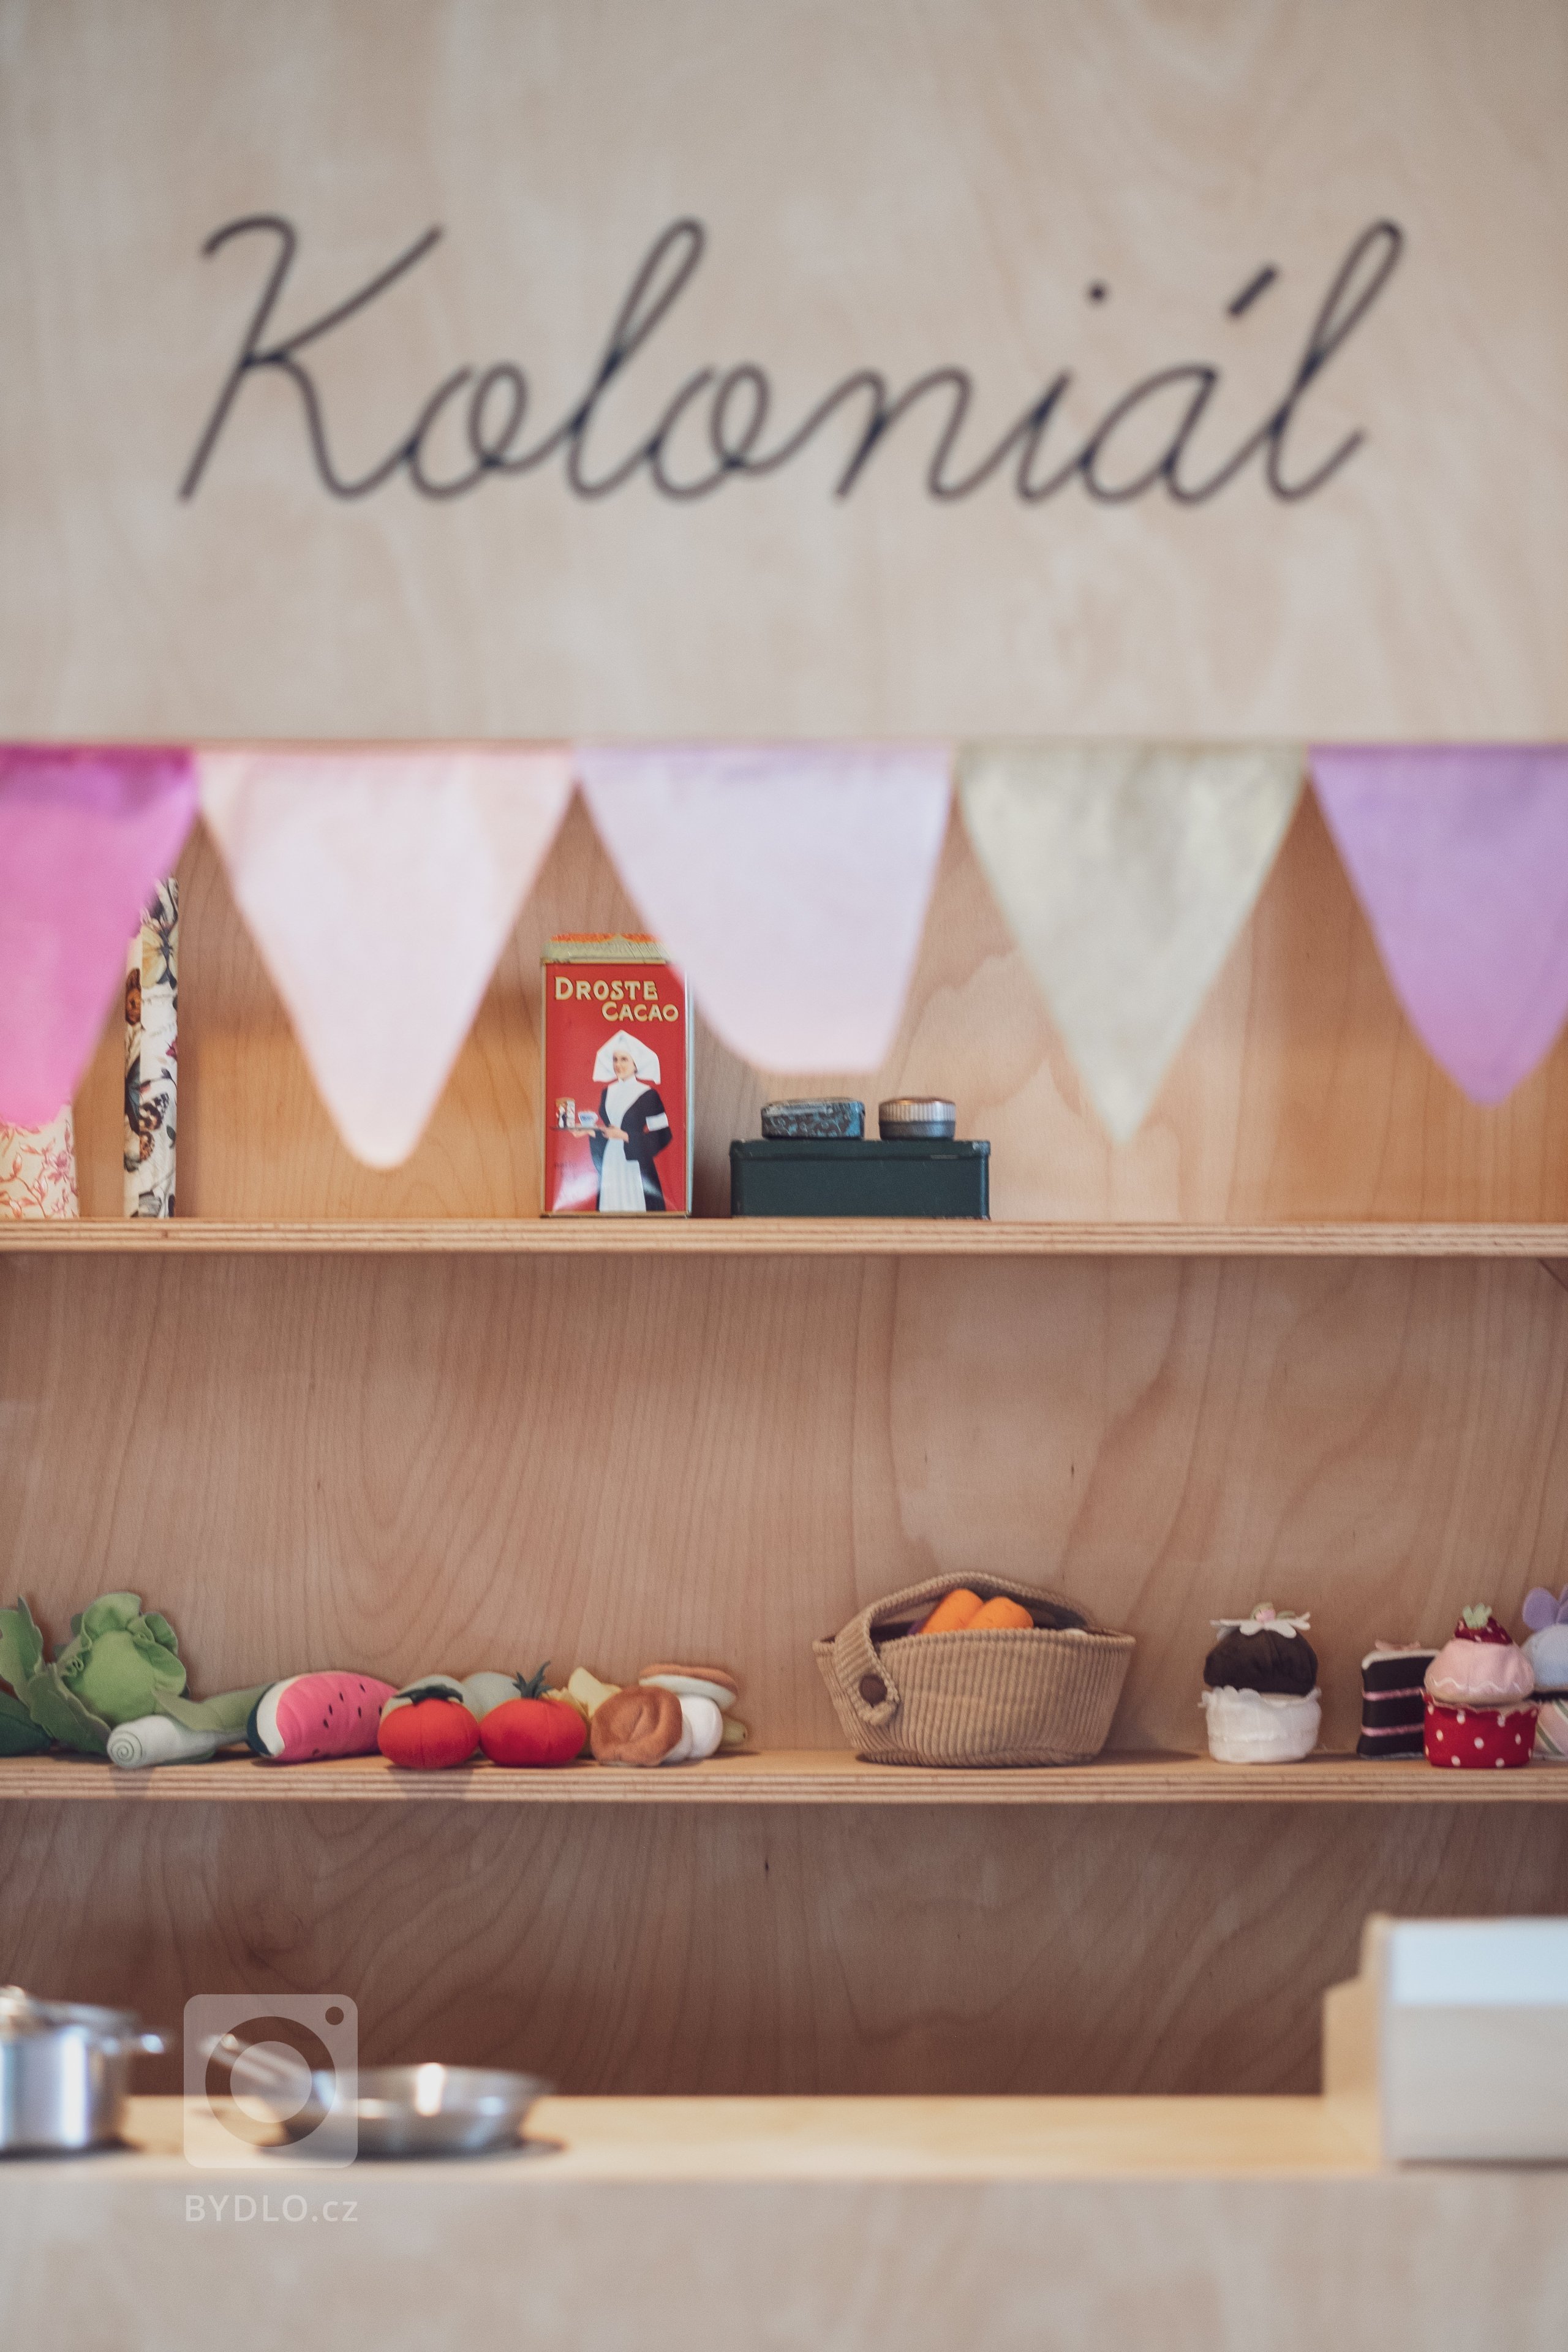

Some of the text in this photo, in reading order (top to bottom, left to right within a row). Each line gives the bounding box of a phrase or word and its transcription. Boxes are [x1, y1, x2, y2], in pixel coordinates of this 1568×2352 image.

[176, 214, 1405, 505] Koloniál
[554, 976, 658, 1001] DROSTE
[601, 1001, 679, 1022] CACAO
